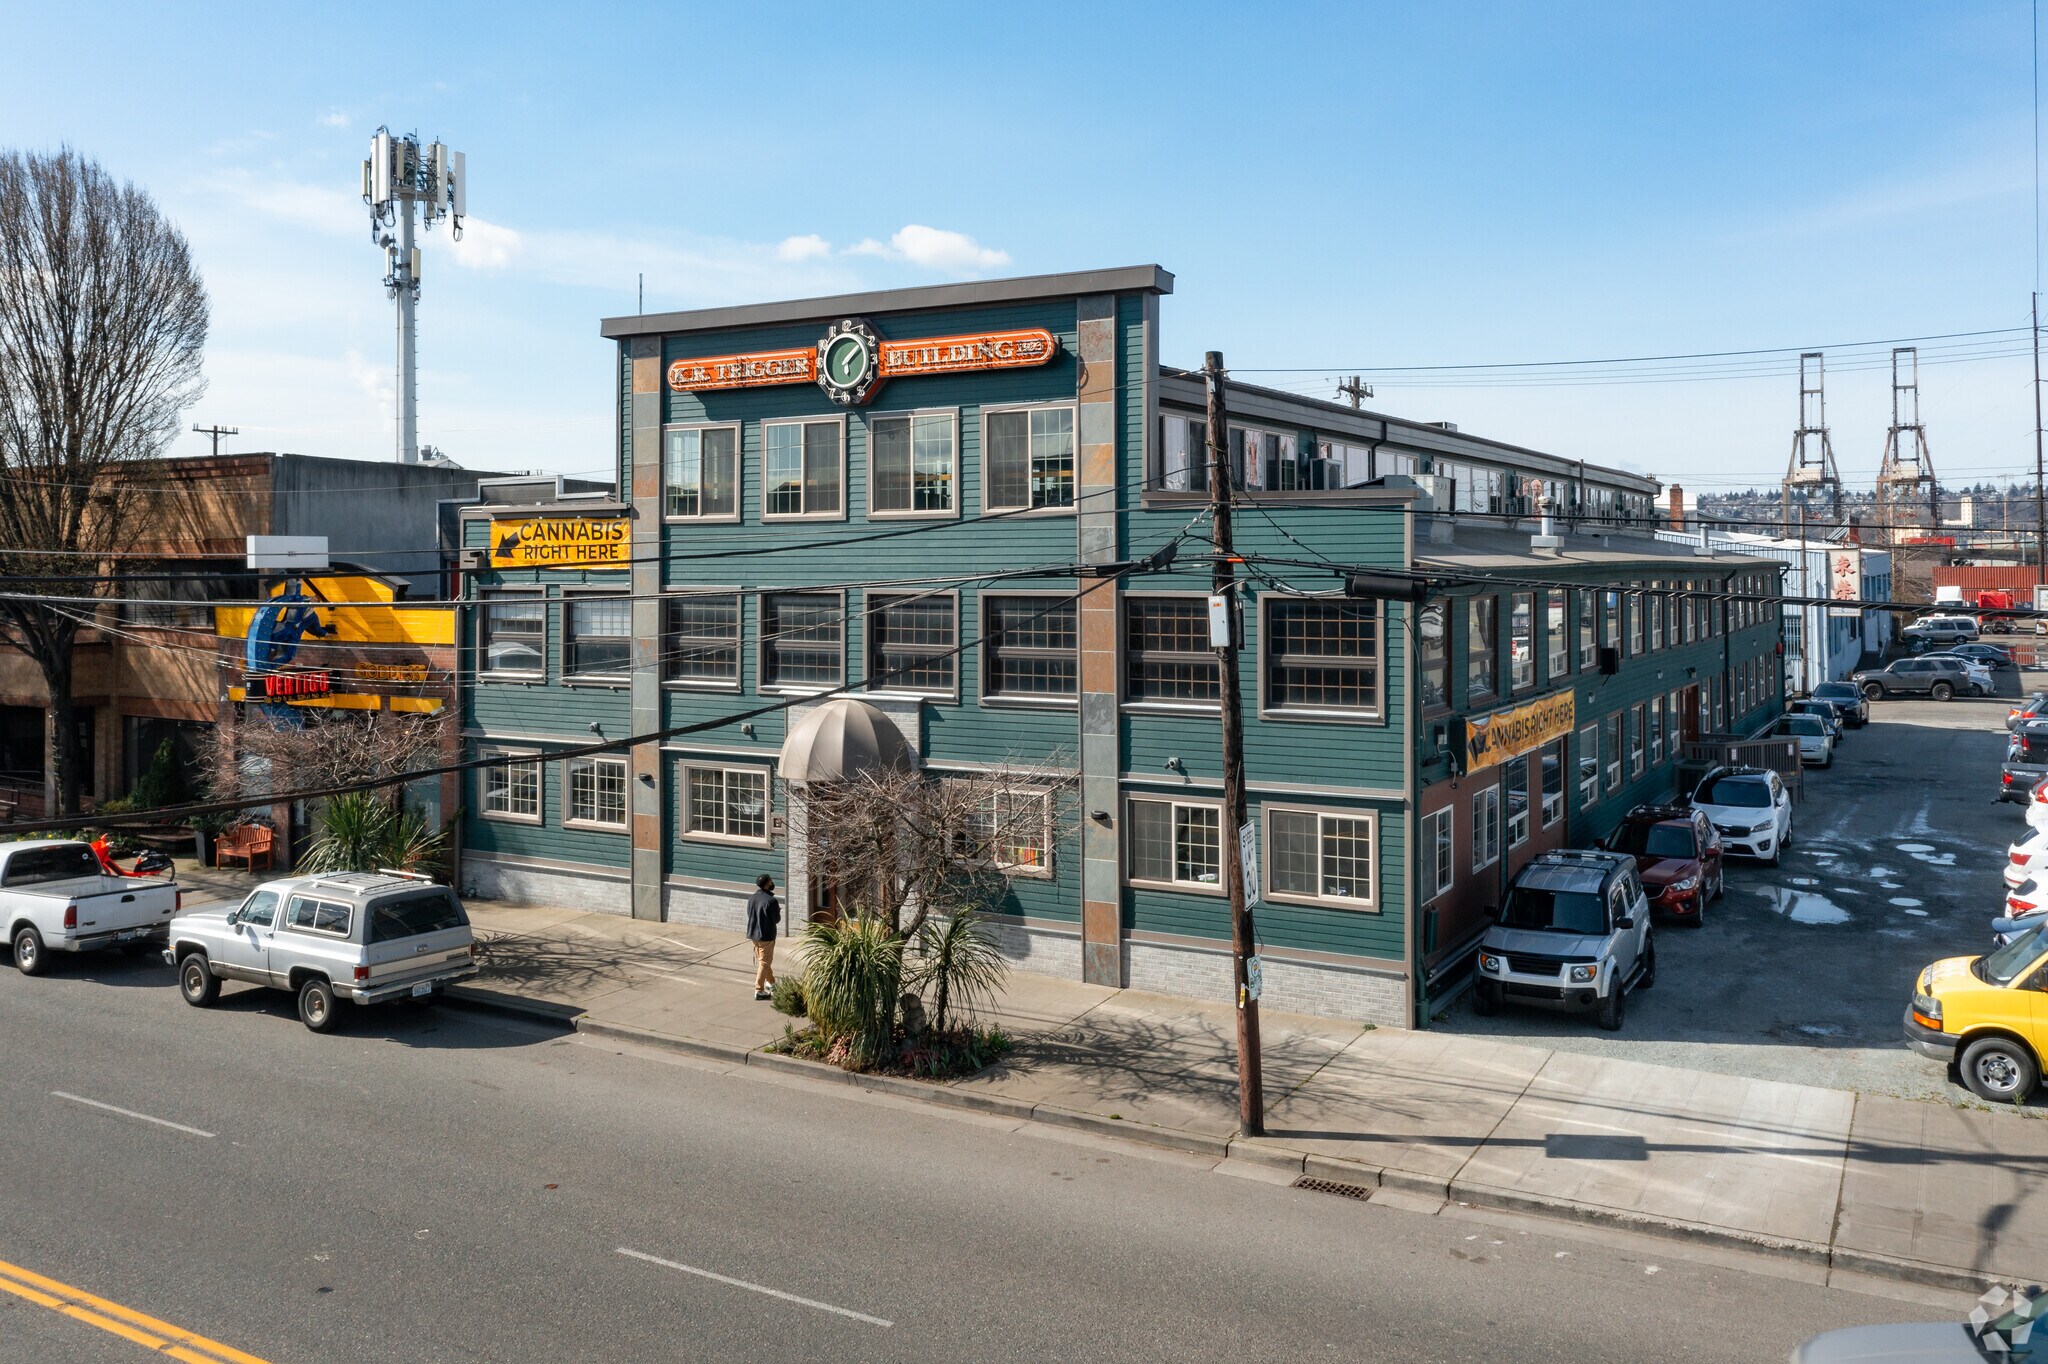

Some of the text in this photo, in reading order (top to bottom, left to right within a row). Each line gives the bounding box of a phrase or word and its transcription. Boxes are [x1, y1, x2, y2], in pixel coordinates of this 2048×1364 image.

[714, 358, 809, 381] TRIGGER
[885, 340, 1014, 367] BUILDING
[520, 522, 624, 541] CANNABIS
[524, 543, 619, 559] RIGHT HERE
[356, 662, 420, 681] GODDESS
[264, 672, 329, 697] VERTIGO
[1485, 701, 1573, 753] CANNABIS RIGHT HERE
[1246, 866, 1257, 900] 30
